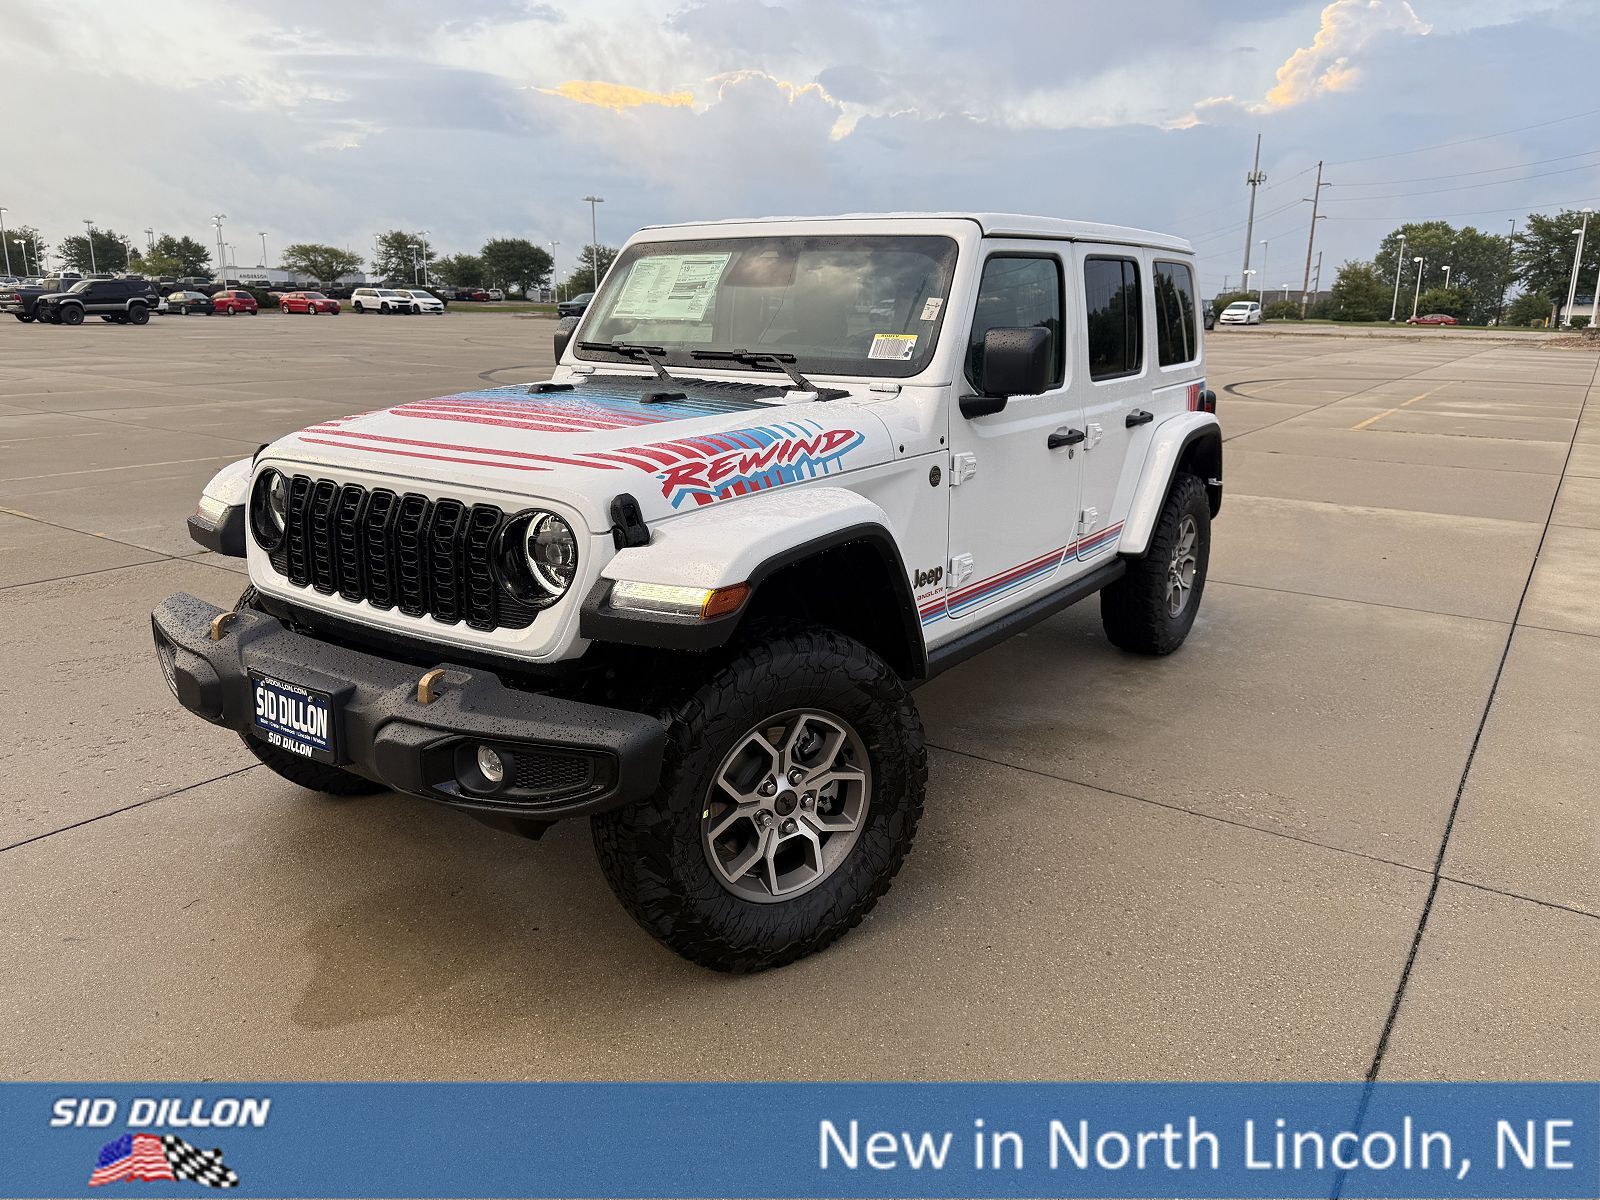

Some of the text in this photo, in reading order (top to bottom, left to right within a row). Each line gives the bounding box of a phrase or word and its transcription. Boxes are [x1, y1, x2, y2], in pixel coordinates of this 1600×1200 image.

[661, 429, 856, 500] REWIND
[913, 565, 943, 590] Jeep
[256, 687, 328, 740] SID DILLON
[268, 732, 313, 758] SID DILLON
